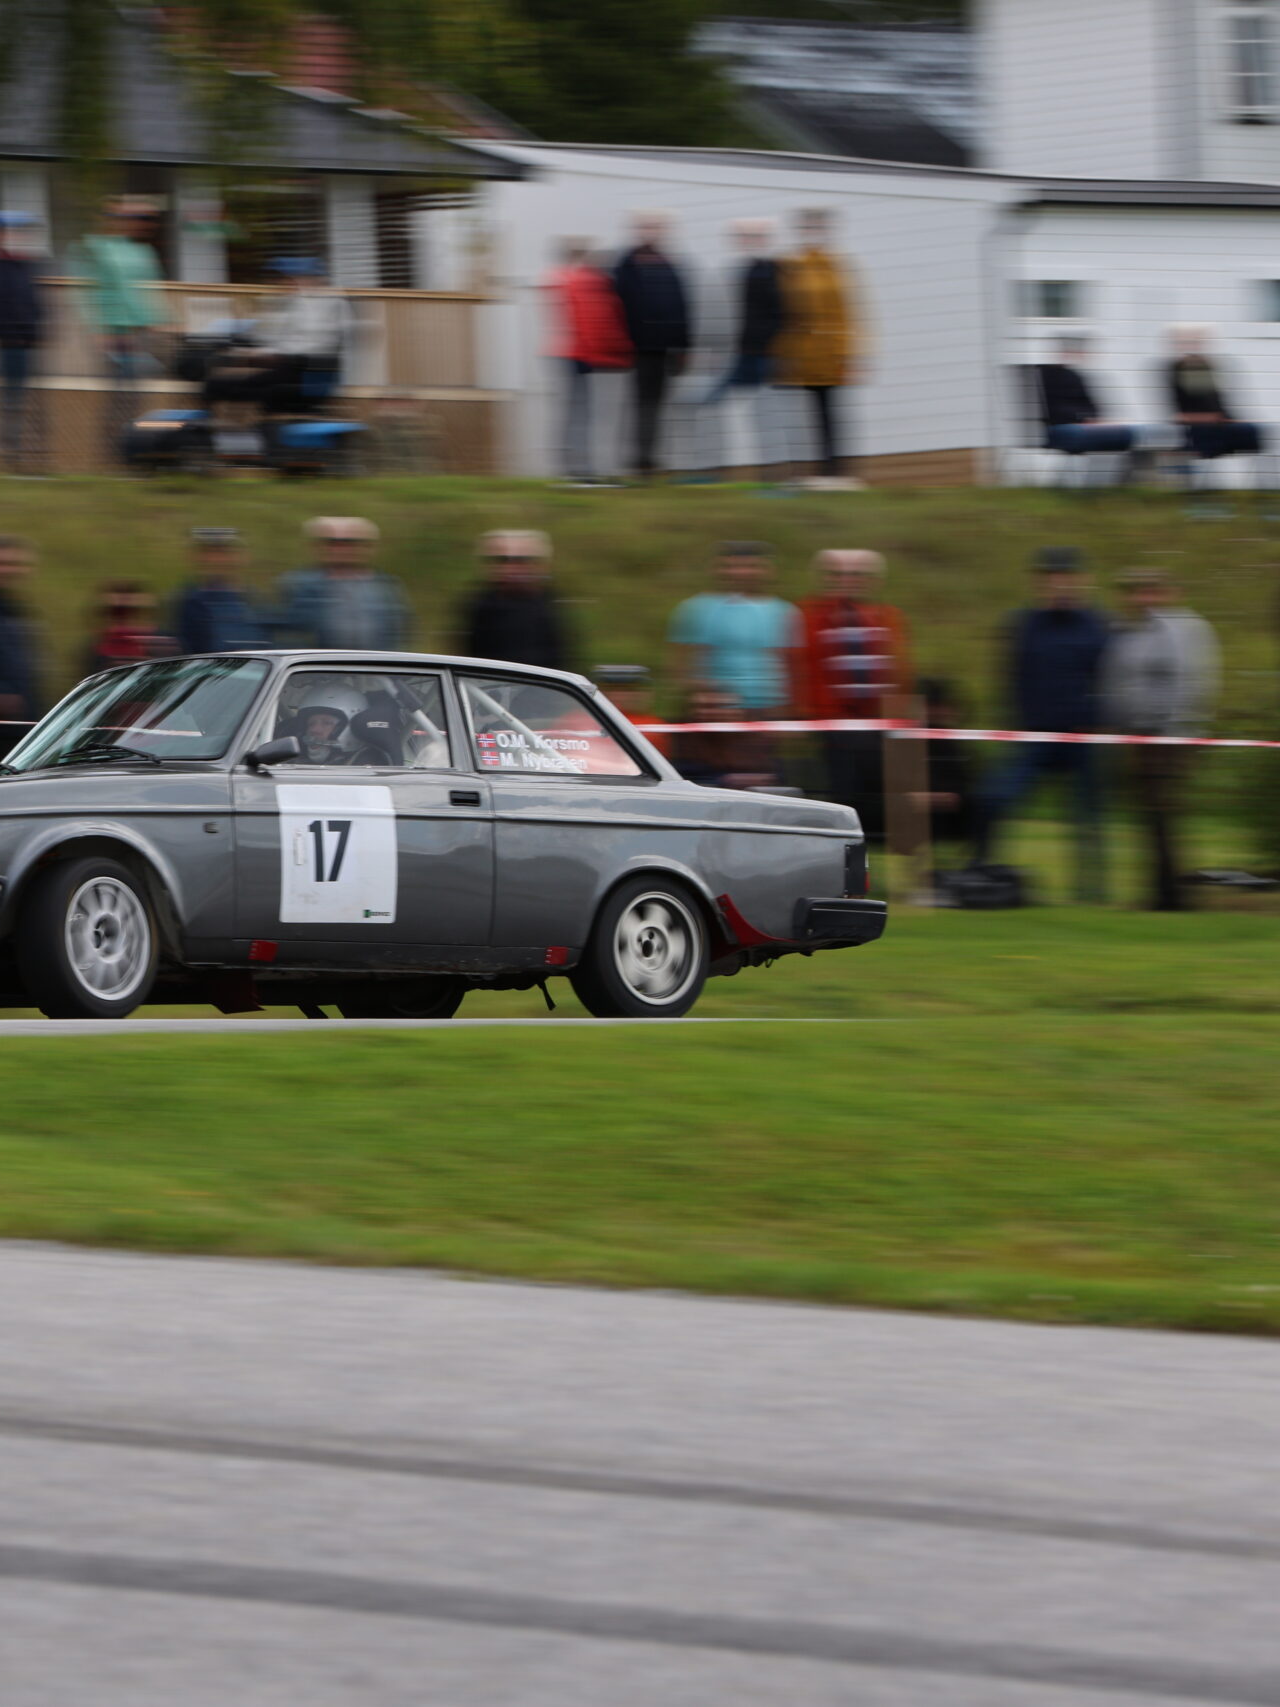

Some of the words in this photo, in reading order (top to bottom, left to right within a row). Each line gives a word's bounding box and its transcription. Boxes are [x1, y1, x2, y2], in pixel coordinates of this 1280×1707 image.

[534, 734, 590, 751] Korsmo
[499, 752, 519, 768] M.
[308, 820, 352, 882] 17
